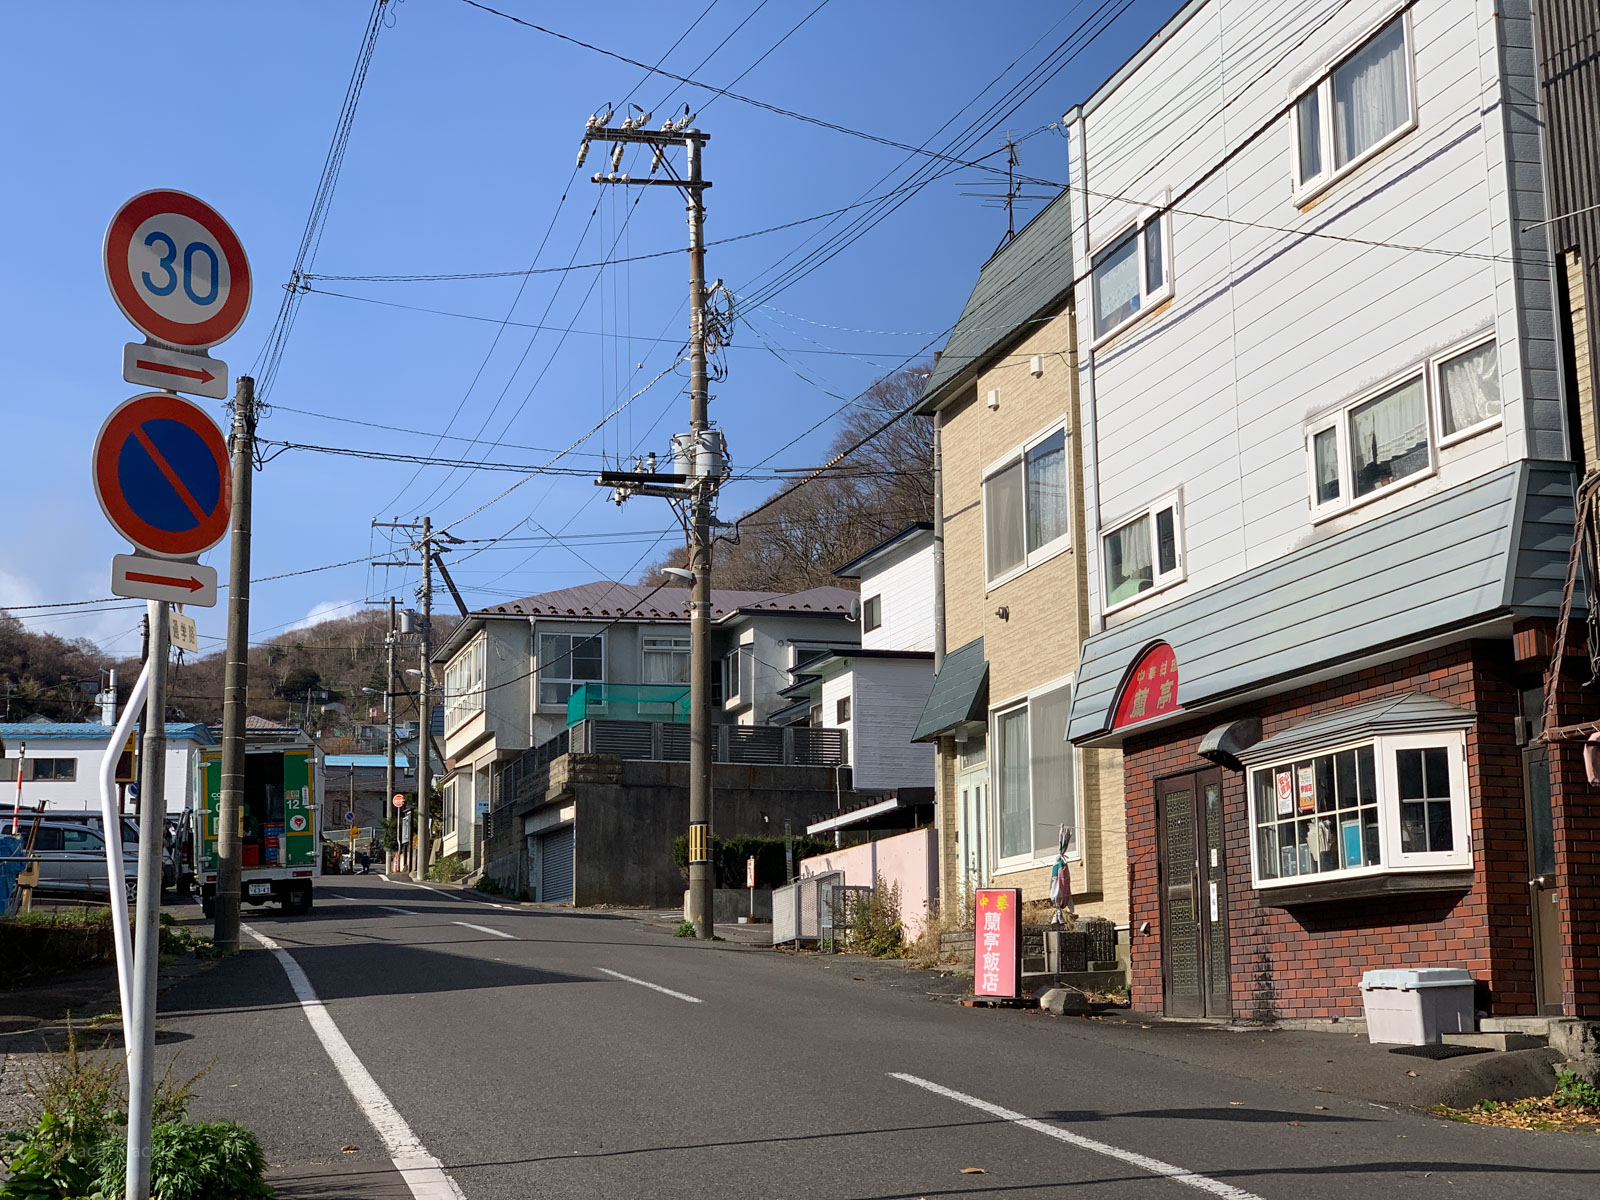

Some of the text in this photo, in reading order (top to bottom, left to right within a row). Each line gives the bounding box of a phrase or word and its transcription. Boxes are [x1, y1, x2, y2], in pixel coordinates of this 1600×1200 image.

[142, 231, 218, 306] 30
[1137, 657, 1178, 684] 中華料理
[1129, 680, 1174, 718] 蘭亭
[286, 800, 300, 810] 12
[979, 893, 1009, 912] 中華
[982, 912, 1002, 992] 蘭亭飯店
